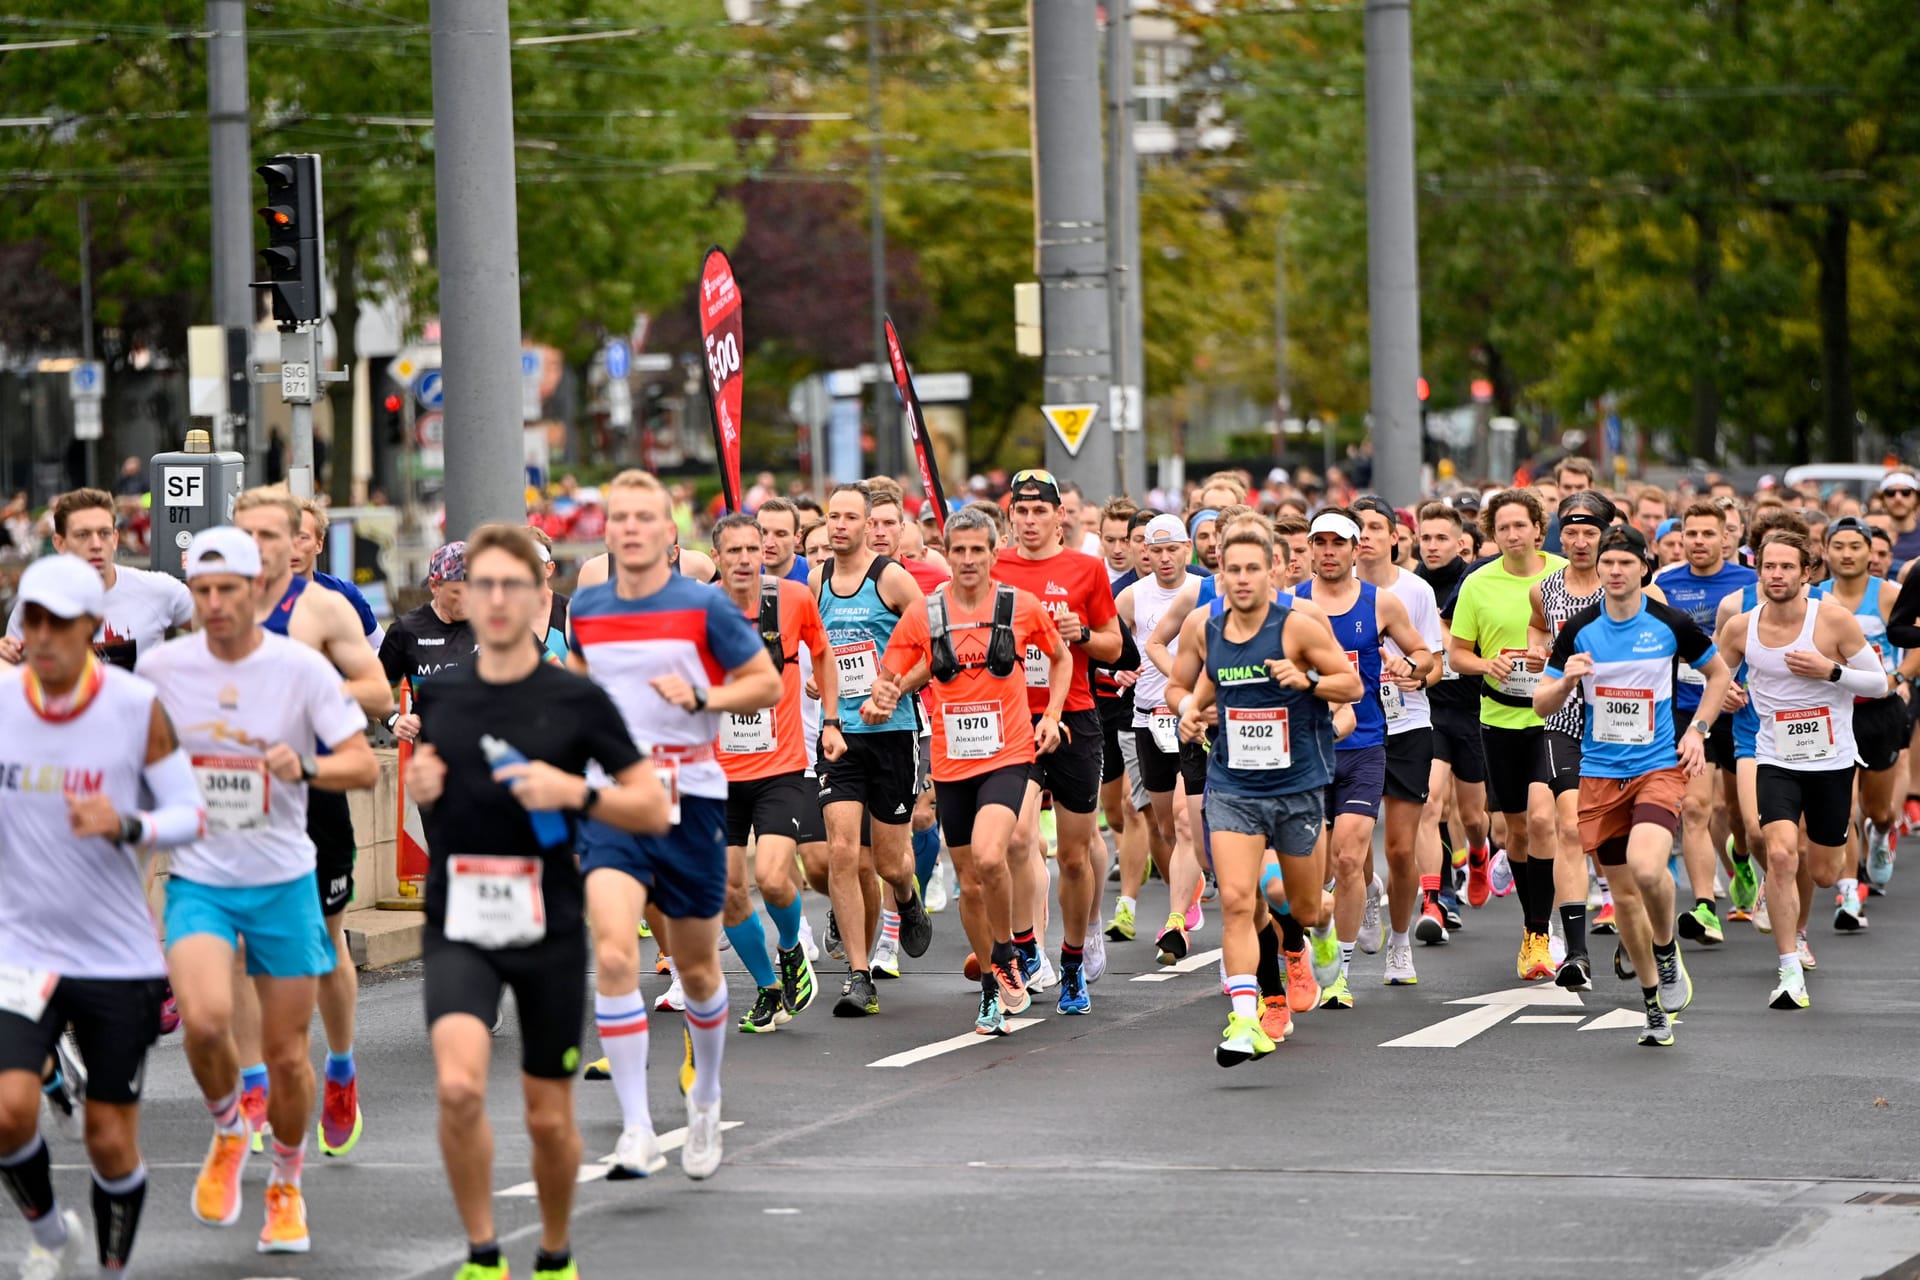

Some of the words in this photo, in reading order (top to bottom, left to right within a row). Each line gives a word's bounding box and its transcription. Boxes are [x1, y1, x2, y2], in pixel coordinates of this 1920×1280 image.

[283, 366, 308, 378] SIG.
[285, 382, 306, 393] 871
[1064, 410, 1079, 436] 2
[168, 476, 201, 497] SF
[169, 507, 191, 524] 871
[838, 656, 865, 671] 1911
[844, 674, 864, 682] Oliver
[1217, 665, 1254, 681] PUMA
[1612, 689, 1644, 698] GENERALI
[1606, 702, 1640, 715] 3062
[730, 712, 762, 726] 1402
[957, 716, 989, 730] 1970
[1239, 725, 1273, 738] 4202
[1787, 721, 1819, 736] 2892
[955, 734, 993, 743] Alexander
[1242, 744, 1272, 752] Markus
